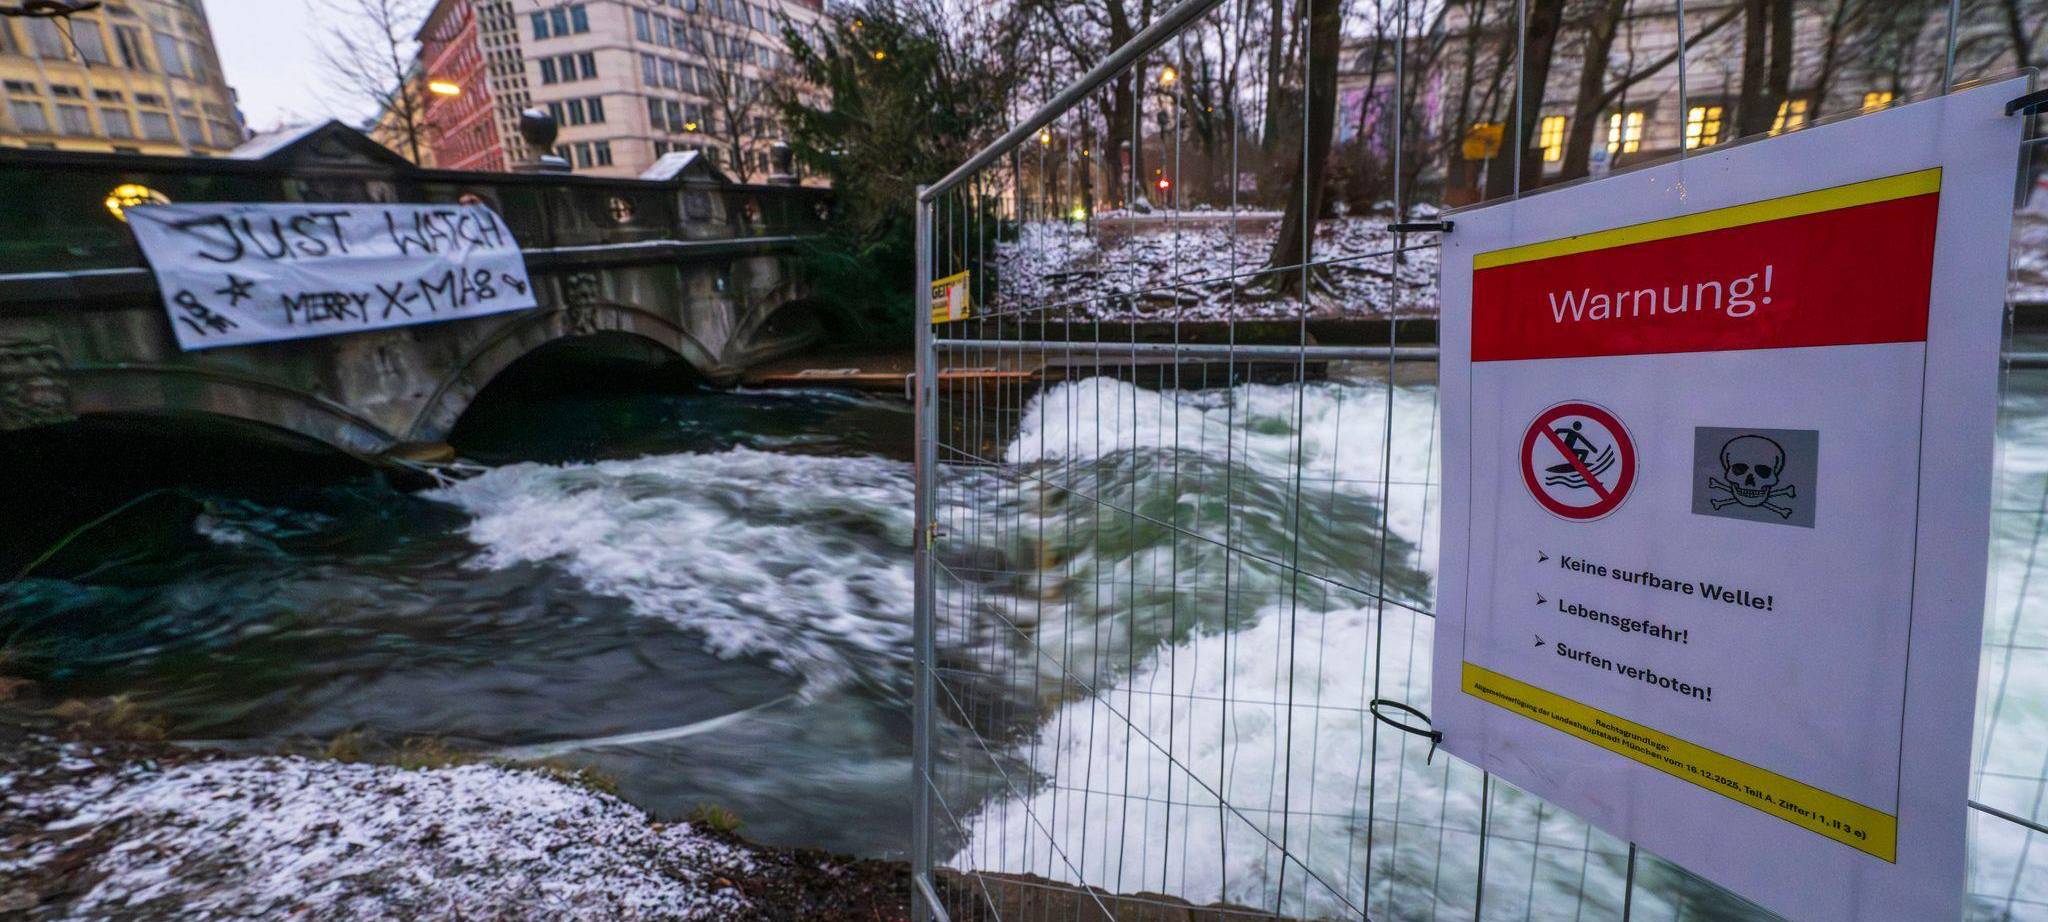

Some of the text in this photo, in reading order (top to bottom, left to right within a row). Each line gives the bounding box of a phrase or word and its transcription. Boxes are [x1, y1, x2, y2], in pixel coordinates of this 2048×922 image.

[170, 210, 504, 263] JUST WATCH
[281, 291, 370, 324] MERRY
[1549, 264, 1773, 324] Warnung!
[1560, 555, 1774, 612] Keine surfbare Welle!
[1559, 599, 1689, 644] Lebensgefahr!
[1556, 642, 1712, 702] Surfen verboten!
[1595, 719, 1670, 752] Rechtsgrundlage:
[1551, 712, 1620, 744] Landeshauptstadt
[1621, 738, 1662, 760] München
[1663, 756, 1684, 768] vom
[1744, 785, 1763, 800] Teil
[1778, 799, 1809, 817] Ziffer
[1843, 823, 1852, 833] 3
[1854, 829, 1867, 840] e)
